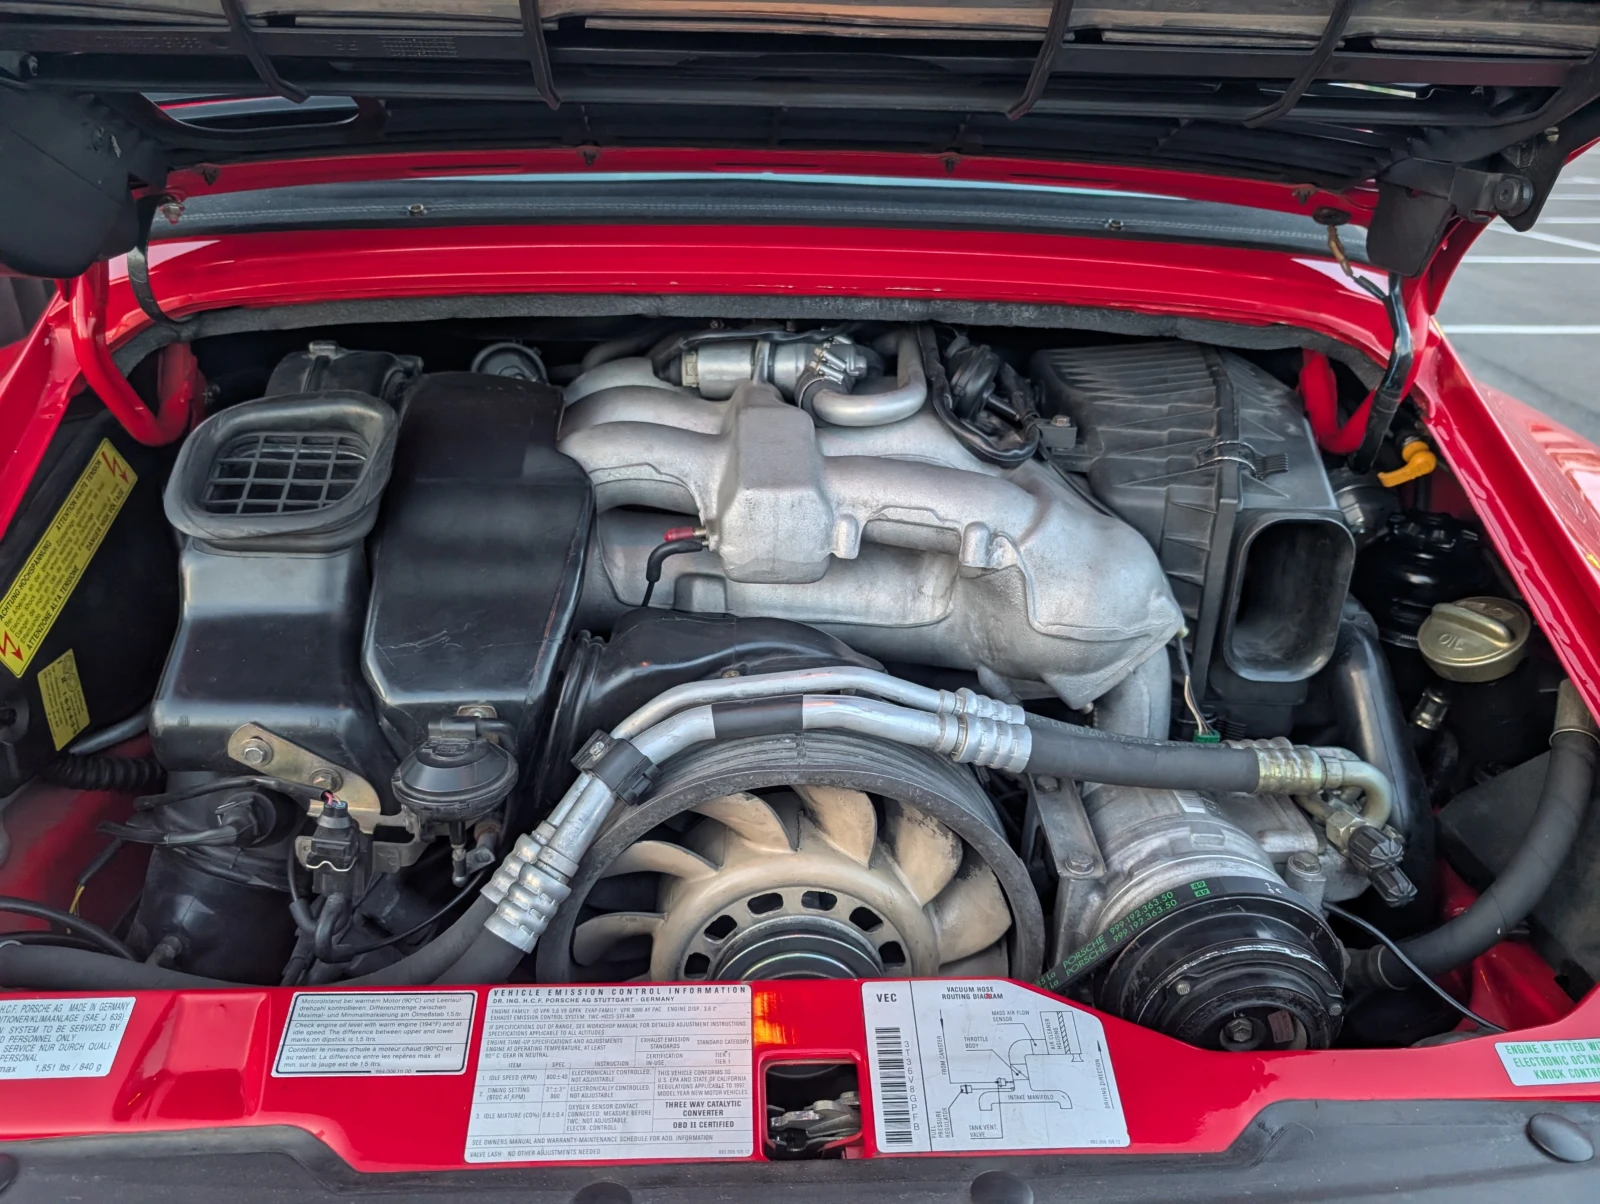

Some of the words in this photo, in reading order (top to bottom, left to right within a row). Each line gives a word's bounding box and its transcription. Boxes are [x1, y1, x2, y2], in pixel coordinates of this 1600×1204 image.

[0, 589, 20, 620] ACHTUNG
[19, 540, 52, 589] HOCHSPANNUNG
[26, 611, 53, 650] ATTENZIONE
[50, 594, 62, 611] ALTA
[60, 565, 80, 594] TENSIONE
[1063, 935, 1106, 969] PORSCHE
[1109, 891, 1174, 935] 999.192.363.50
[1066, 943, 1108, 977] PORSCHE
[1112, 899, 1178, 942] 999.192.363.50
[876, 994, 897, 1002] VEC
[20, 1004, 51, 1013] PORSCHE
[53, 1004, 63, 1012] AG
[69, 1003, 88, 1012] MADE
[89, 1003, 96, 1011] IN
[99, 1002, 130, 1011] GERMANY
[110, 1013, 124, 1022] 639)
[9, 1026, 39, 1034] SYSTEM
[70, 1024, 106, 1032] SERVICED
[1045, 1018, 1054, 1039] CLEANER
[8, 1035, 52, 1044] PERSONNEL
[1053, 1028, 1062, 1050] HOUSING
[3, 1044, 36, 1052] SERVICE
[58, 1043, 84, 1051] DURCH
[88, 1042, 112, 1050] QUALI-
[1505, 1044, 1539, 1054] ENGINE
[1541, 1044, 1551, 1053] IS
[1553, 1042, 1585, 1053] FITTED
[0, 1054, 38, 1062] PERSONAL
[1513, 1056, 1569, 1067] ELECTRONIC
[1570, 1054, 1600, 1065] OCTAN
[80, 1064, 94, 1072] 840
[96, 1063, 102, 1072] g
[1094, 1058, 1106, 1085] DIRECTION
[1533, 1069, 1566, 1079] KNOCK
[1102, 1085, 1110, 1109] DRIVING
[942, 1108, 950, 1138] REGULATOR
